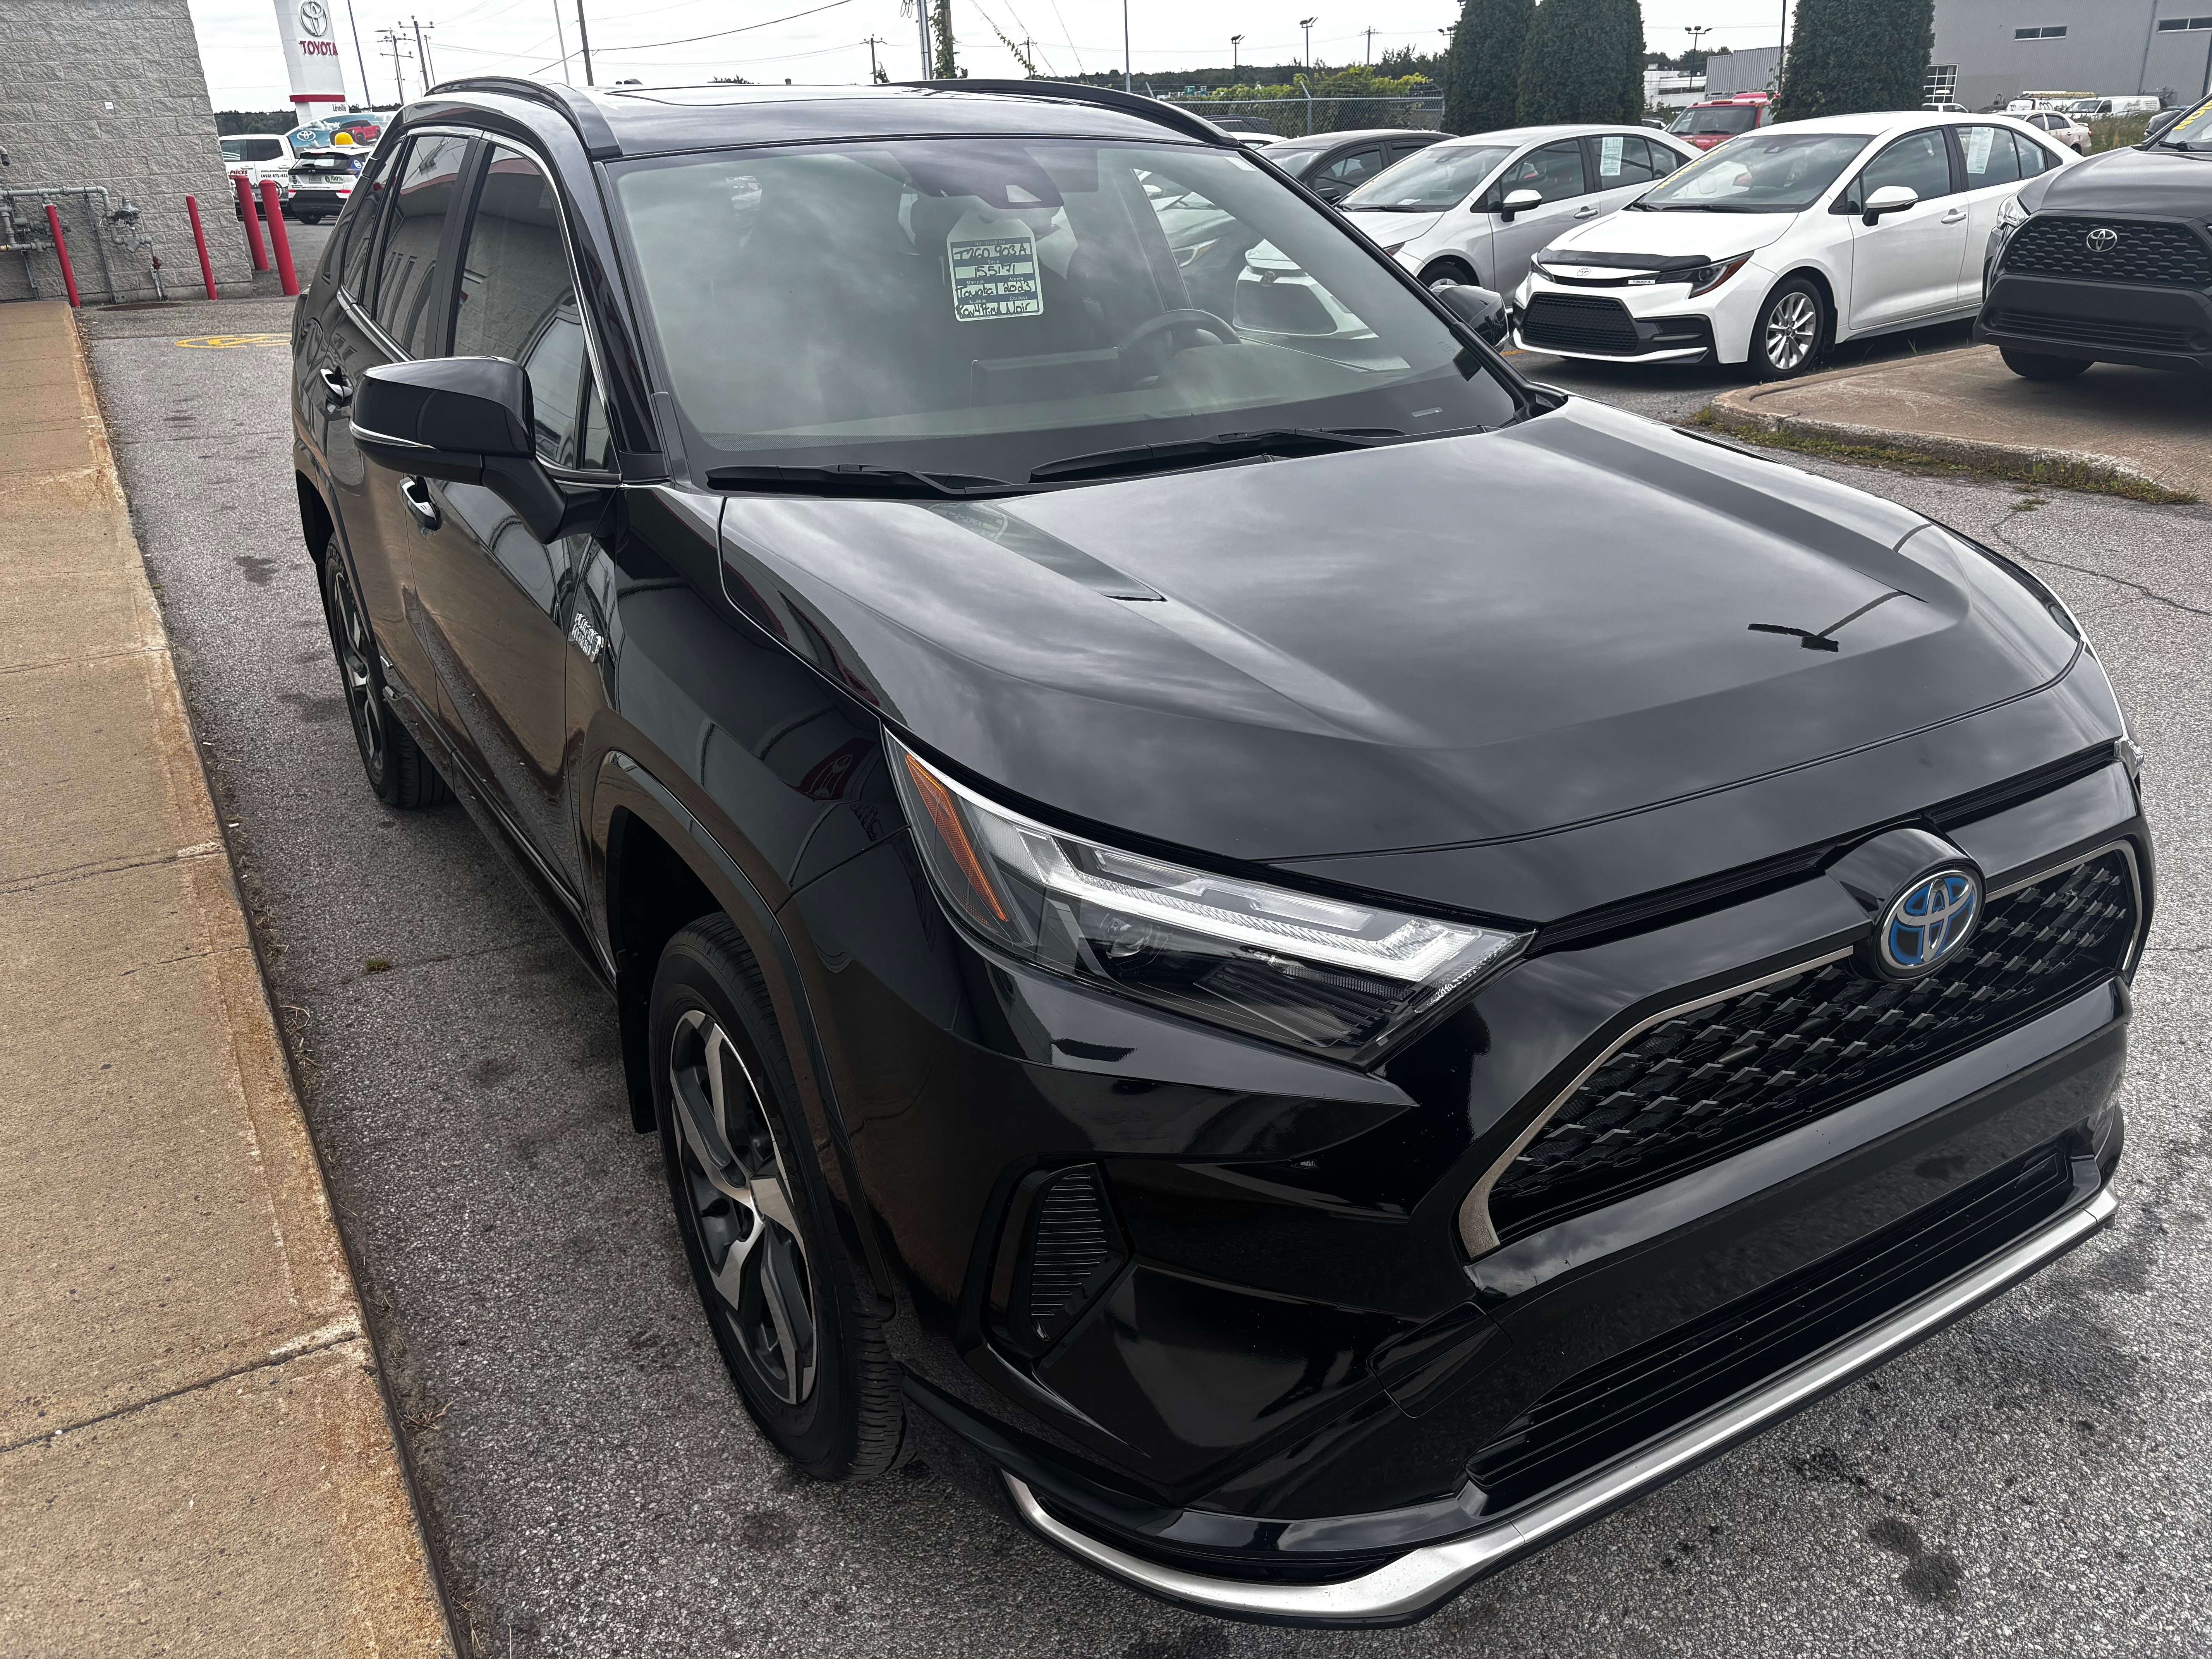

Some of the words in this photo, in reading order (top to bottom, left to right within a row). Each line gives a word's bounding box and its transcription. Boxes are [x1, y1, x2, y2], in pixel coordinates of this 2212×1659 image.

[299, 40, 338, 56] TOYOTA
[1003, 281, 1032, 293] 2023
[1005, 301, 1030, 315] Noir
